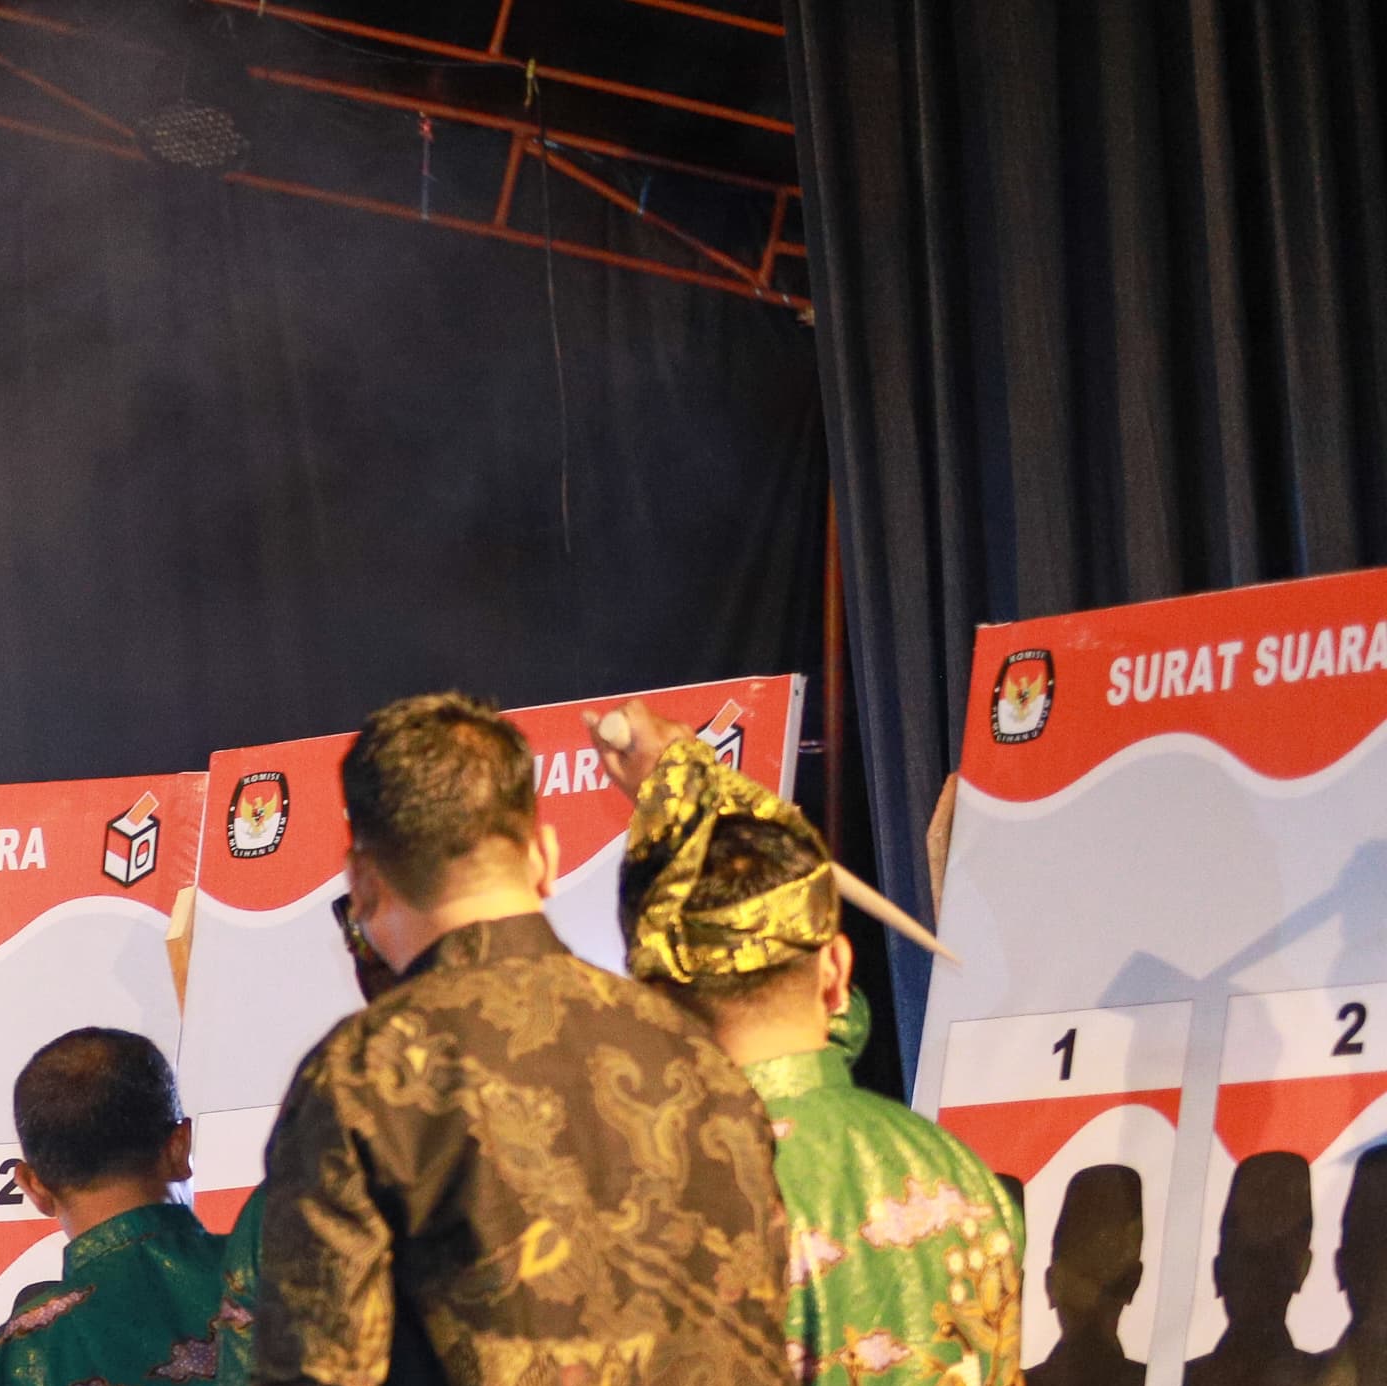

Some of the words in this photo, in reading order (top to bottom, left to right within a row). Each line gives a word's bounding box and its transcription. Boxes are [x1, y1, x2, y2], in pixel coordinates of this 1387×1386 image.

[1106, 640, 1244, 707] SURAT
[1252, 620, 1387, 687] SUARA
[243, 772, 281, 785] KOMISI
[533, 748, 612, 797] AR
[1052, 1028, 1077, 1081] 1
[1331, 1002, 1366, 1057] 2
